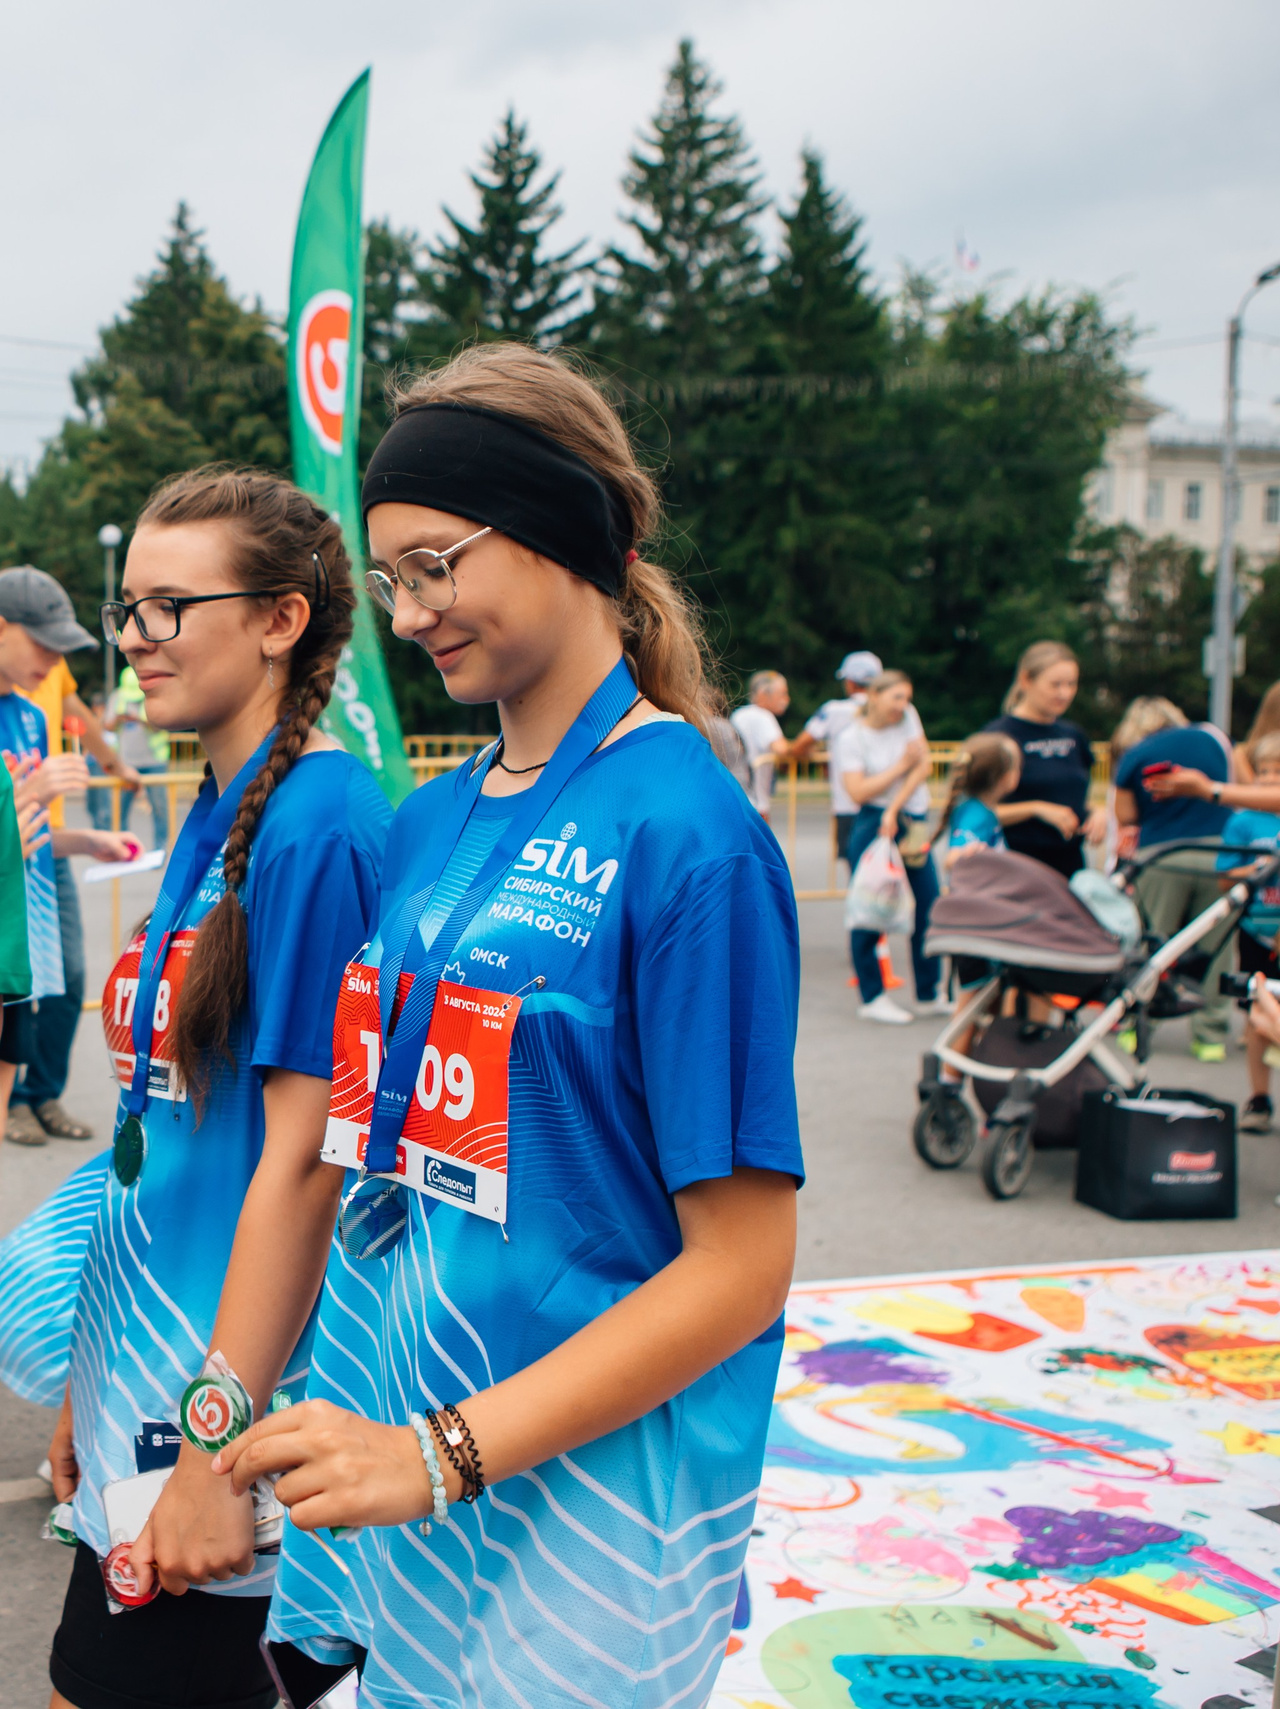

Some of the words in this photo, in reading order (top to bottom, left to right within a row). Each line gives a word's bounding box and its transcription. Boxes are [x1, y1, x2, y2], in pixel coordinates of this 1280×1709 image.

[497, 891, 596, 930] МЕЖДУНАРОДНЫЙ
[504, 876, 603, 917] СИБИРСКИЙ
[487, 902, 592, 948] МАРАФОН
[470, 945, 507, 970] ОМСК
[114, 977, 171, 1032] 178
[444, 994, 449, 1005] 3
[449, 997, 481, 1013] АВГУСТА
[482, 1005, 505, 1018] 2024
[482, 1019, 490, 1028] 10
[490, 1021, 502, 1030] КМ
[360, 1028, 475, 1120] 109
[432, 1170, 473, 1195] Следопыт
